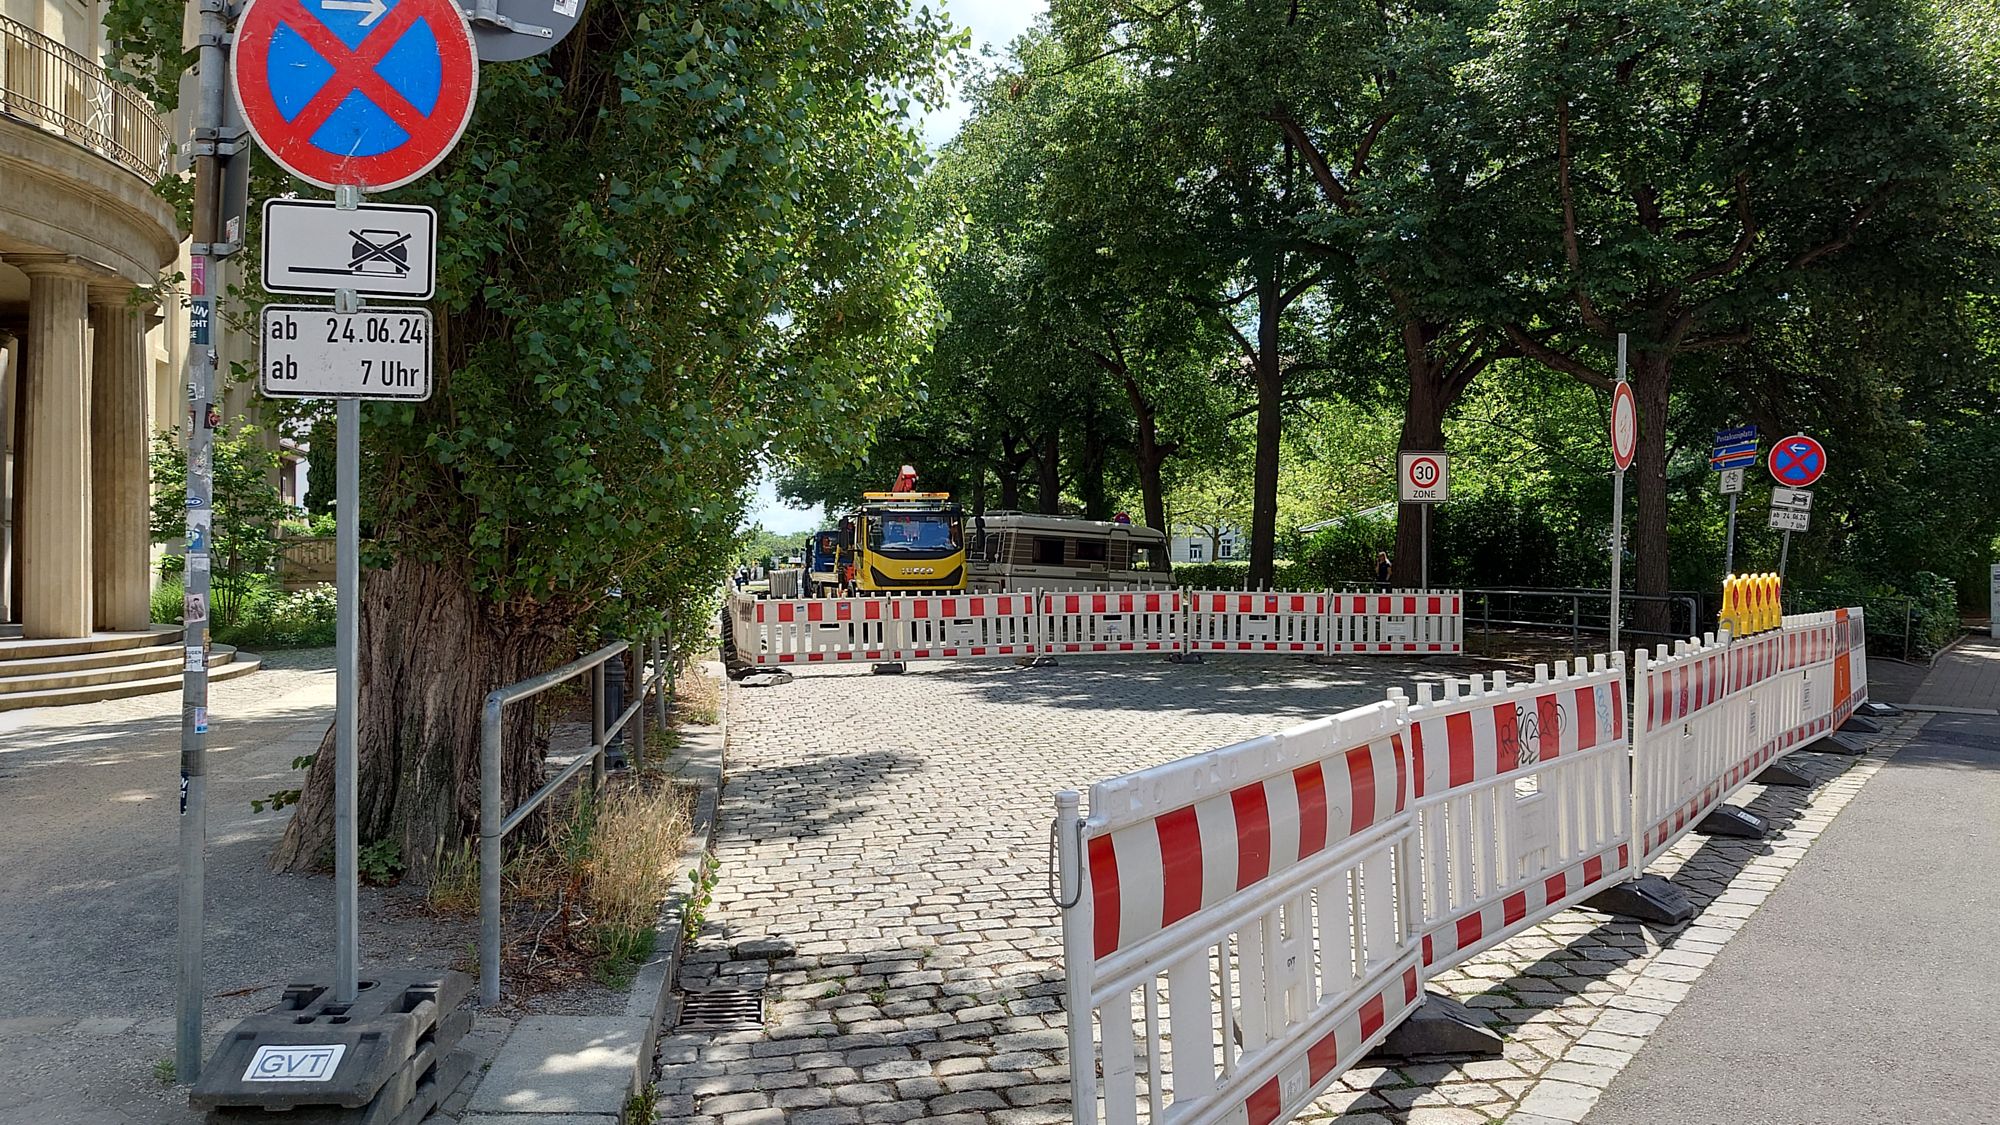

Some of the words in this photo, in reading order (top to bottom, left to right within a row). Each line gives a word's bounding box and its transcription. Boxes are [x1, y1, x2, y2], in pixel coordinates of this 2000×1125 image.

[271, 314, 298, 341] ab
[326, 317, 423, 344] 24.06.24
[271, 354, 298, 380] ab
[361, 360, 372, 386] 7
[381, 360, 420, 387] Uhr
[1415, 465, 1434, 480] 30
[1412, 490, 1437, 498] ZONE
[259, 1054, 329, 1074] GVT
